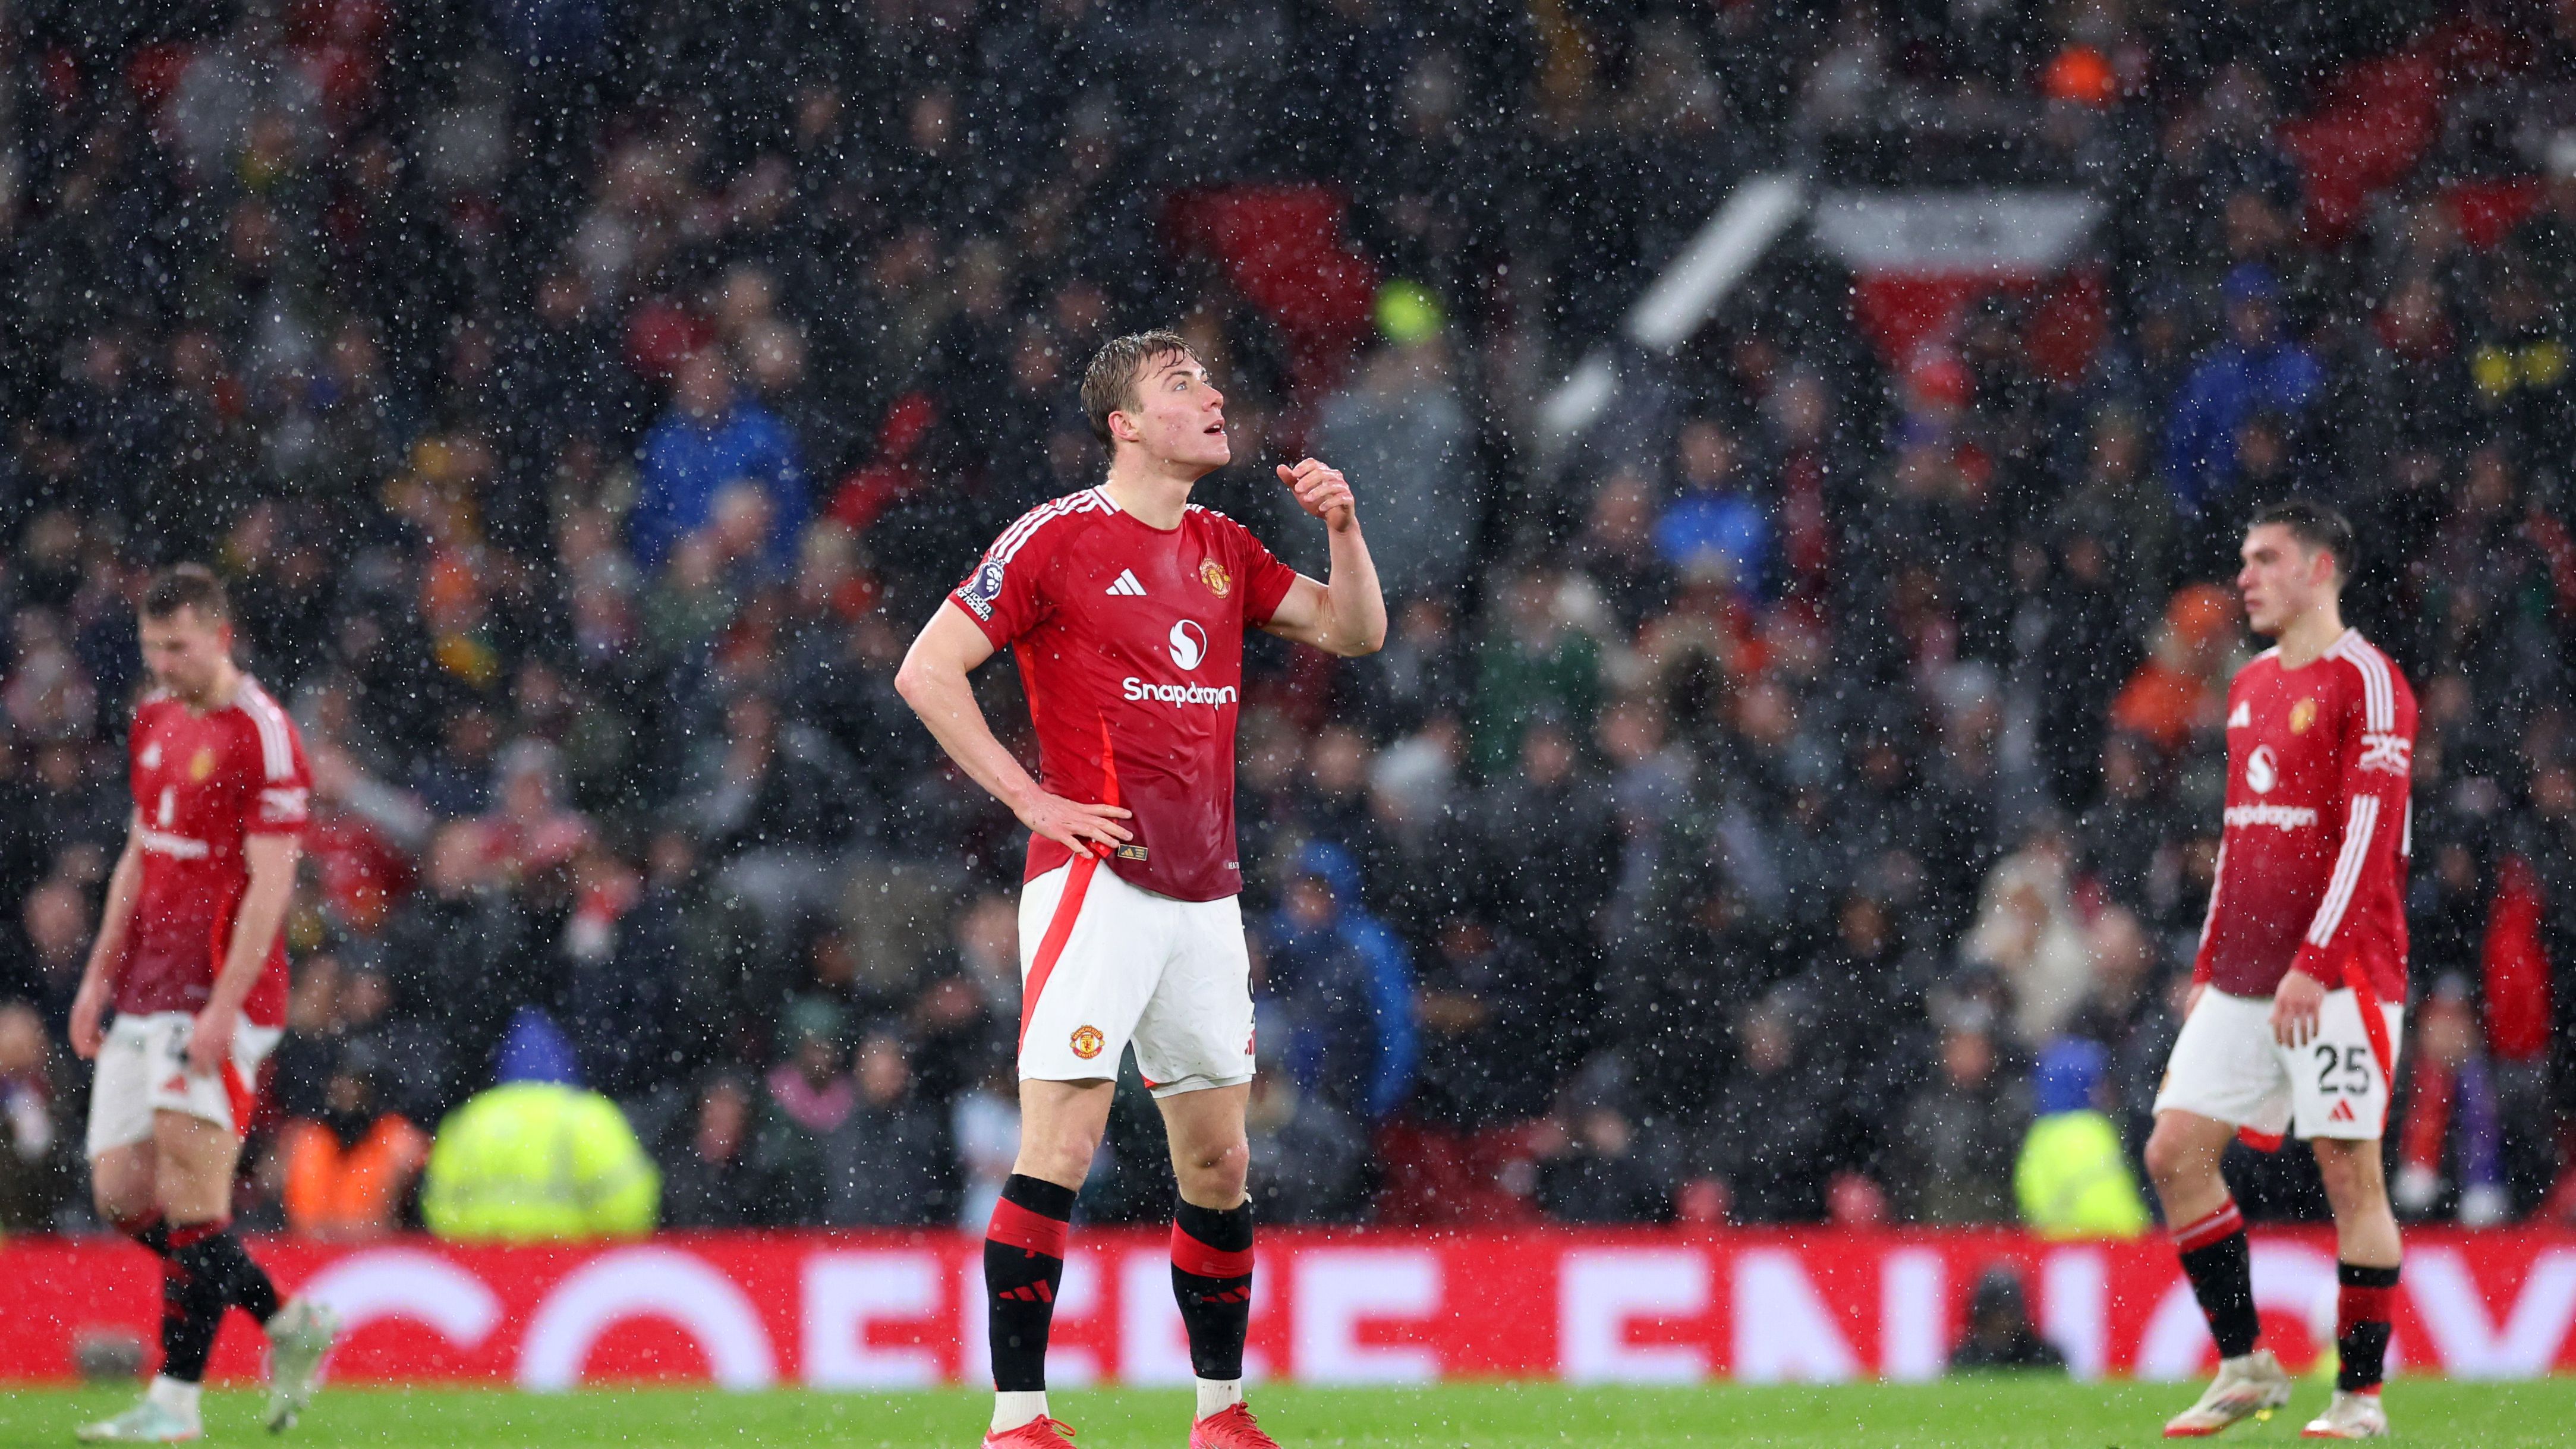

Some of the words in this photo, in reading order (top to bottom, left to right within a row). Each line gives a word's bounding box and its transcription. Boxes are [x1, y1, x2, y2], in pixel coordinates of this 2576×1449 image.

[963, 596, 989, 622] racism
[969, 592, 991, 613] room
[2224, 799, 2317, 832] napdragon
[2315, 1044, 2369, 1095] 25
